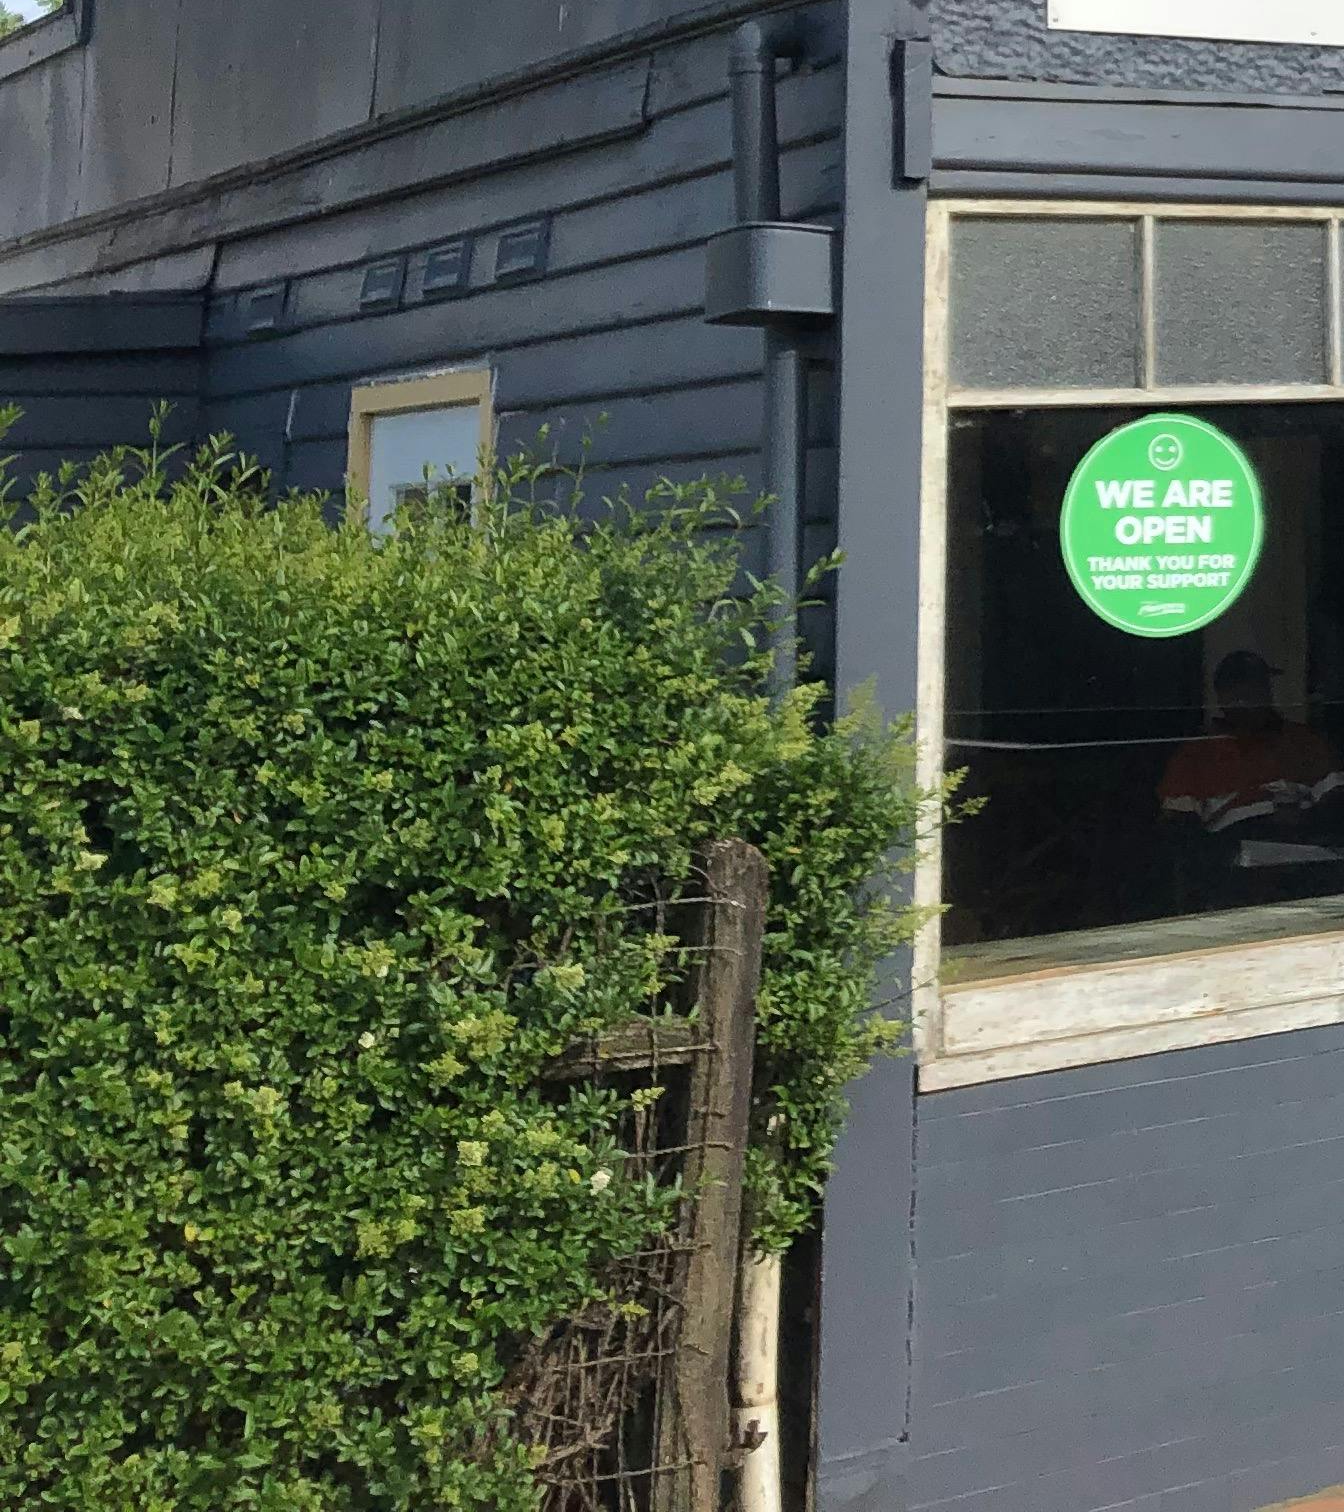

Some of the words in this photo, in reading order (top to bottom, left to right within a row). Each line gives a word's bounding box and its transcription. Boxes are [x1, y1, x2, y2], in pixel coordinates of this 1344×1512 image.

[1094, 479, 1154, 509] WE
[1161, 479, 1233, 508] ARE
[1115, 515, 1212, 545] OPEN
[1087, 555, 1152, 572] THANK
[1157, 555, 1194, 571] YOU
[1198, 553, 1236, 569] FOR
[1092, 574, 1143, 591] YOUR
[1146, 571, 1231, 589] SUPPORT
